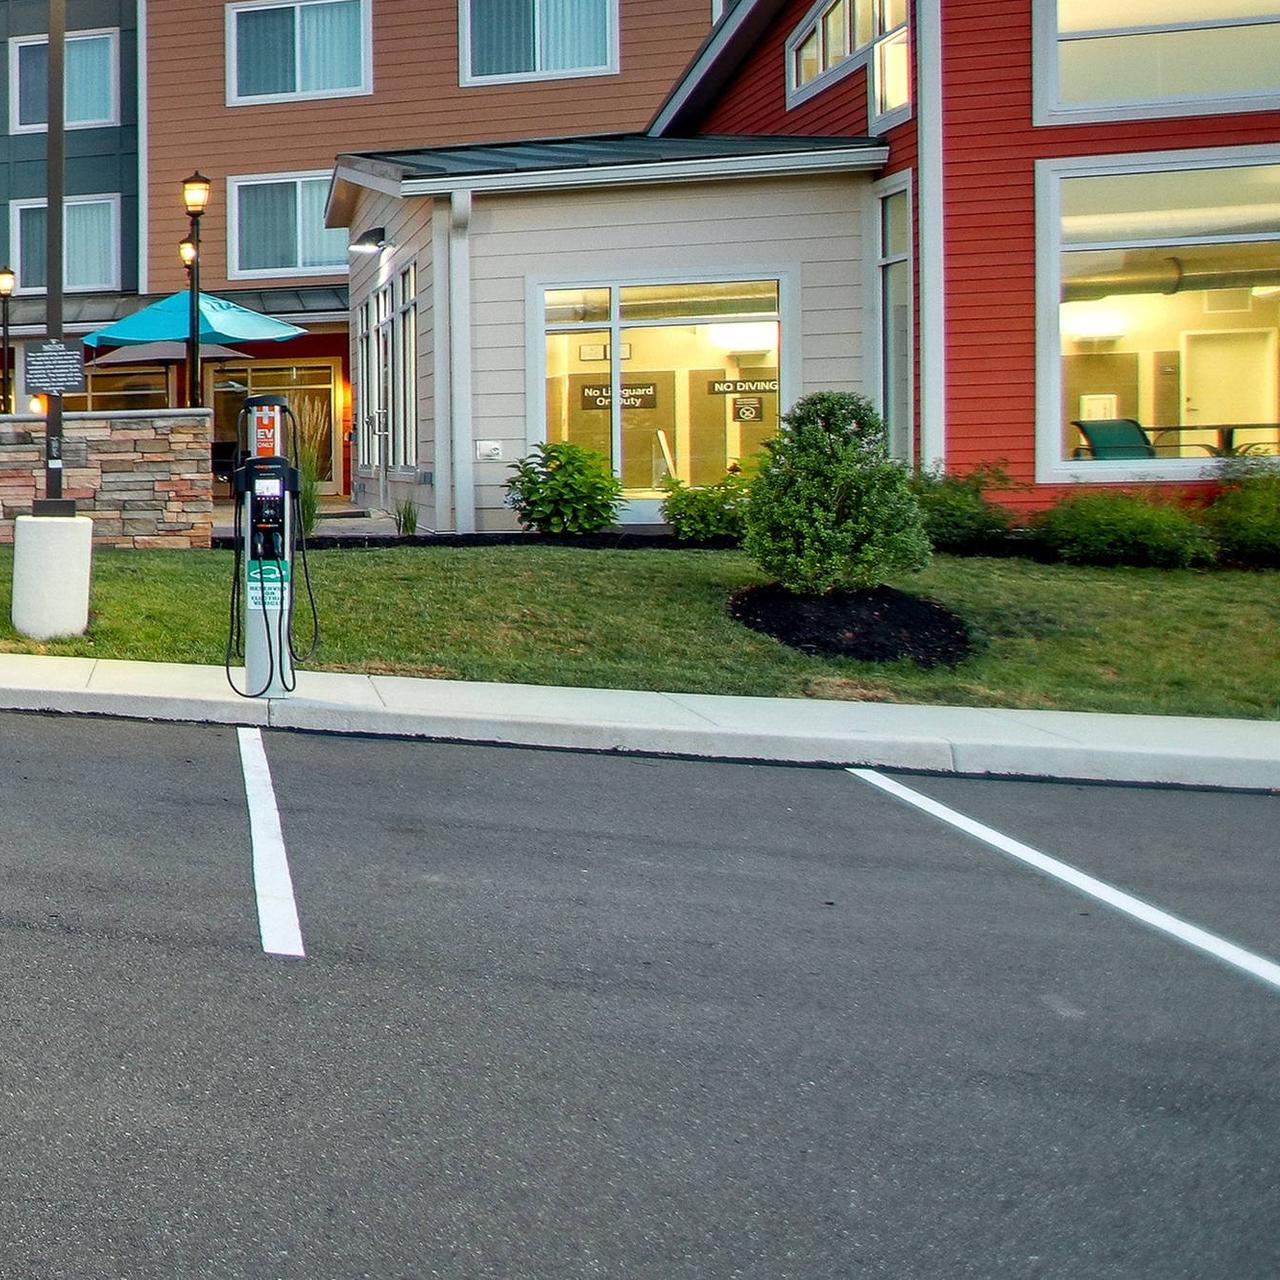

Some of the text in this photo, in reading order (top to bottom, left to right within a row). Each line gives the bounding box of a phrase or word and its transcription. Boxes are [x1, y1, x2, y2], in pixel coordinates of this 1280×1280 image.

[584, 386, 653, 397] No Liguard
[714, 381, 778, 392] NO DIVING
[257, 428, 273, 438] EV
